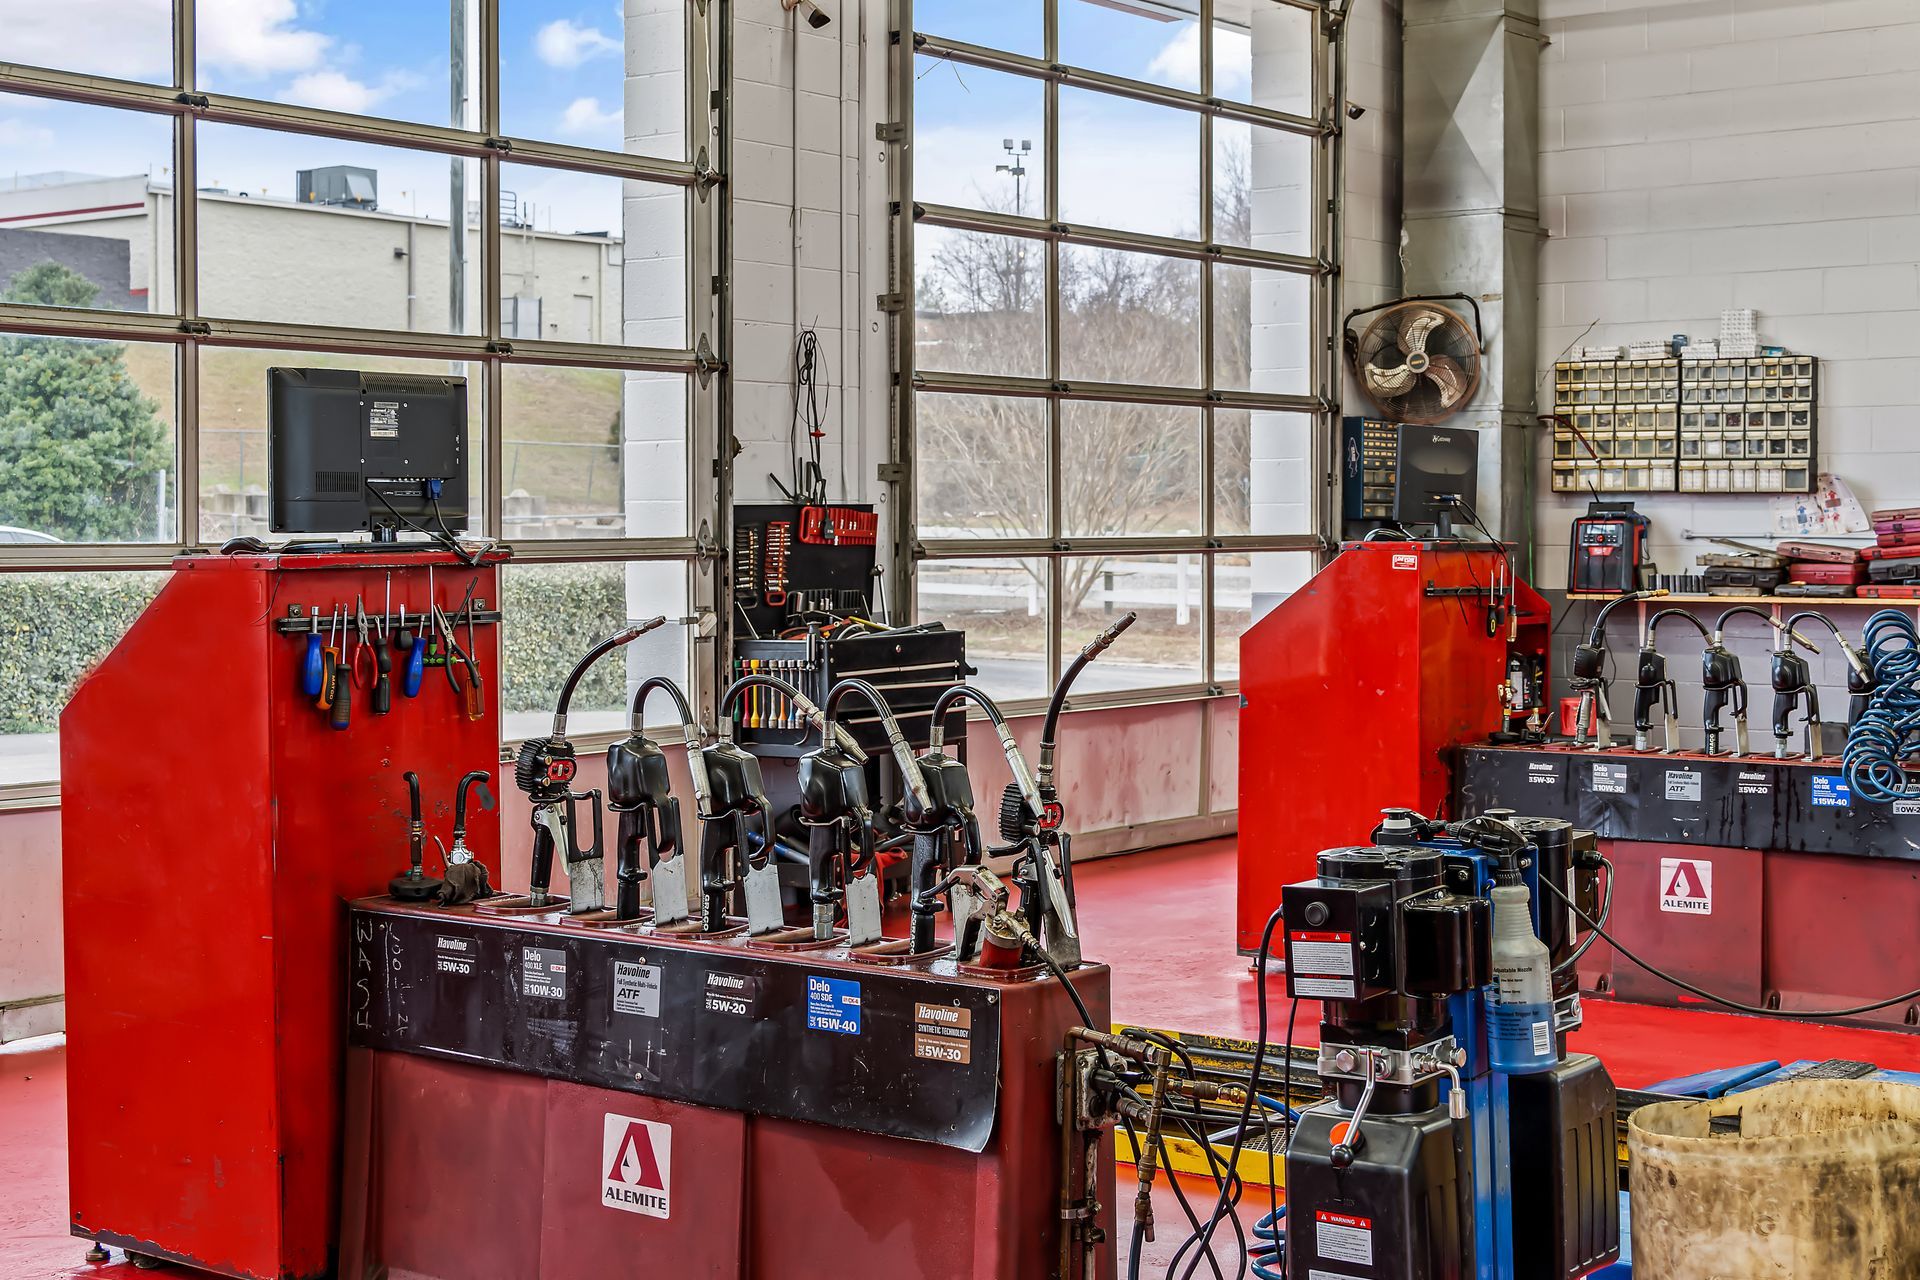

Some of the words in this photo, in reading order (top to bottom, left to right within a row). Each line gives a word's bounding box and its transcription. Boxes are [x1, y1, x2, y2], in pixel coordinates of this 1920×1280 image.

[1739, 772, 1766, 780] Havoline
[1598, 784, 1624, 792] 10W-30
[1663, 900, 1709, 910] ALEMITE
[438, 937, 468, 951] Havoline
[524, 949, 541, 962] Delo
[442, 961, 470, 974] 5W-30
[534, 962, 542, 970] XLE
[617, 964, 650, 979] Havoline
[707, 973, 744, 989] Havoline
[810, 978, 830, 992] Delo
[530, 984, 563, 998] 10W-30
[616, 988, 640, 1000] ATF
[810, 992, 820, 1000] 400
[820, 993, 832, 1002] SDE
[712, 1000, 746, 1015] 5W-20
[918, 1006, 958, 1022] Havoline
[816, 1016, 856, 1032] 15W-40
[918, 1024, 941, 1034] SYNTHETIC
[942, 1026, 968, 1038] TECHNOLOGY
[925, 1046, 961, 1060] 5W-30
[605, 1186, 666, 1210] ALEMITE
[1330, 1216, 1356, 1224] WARNING
